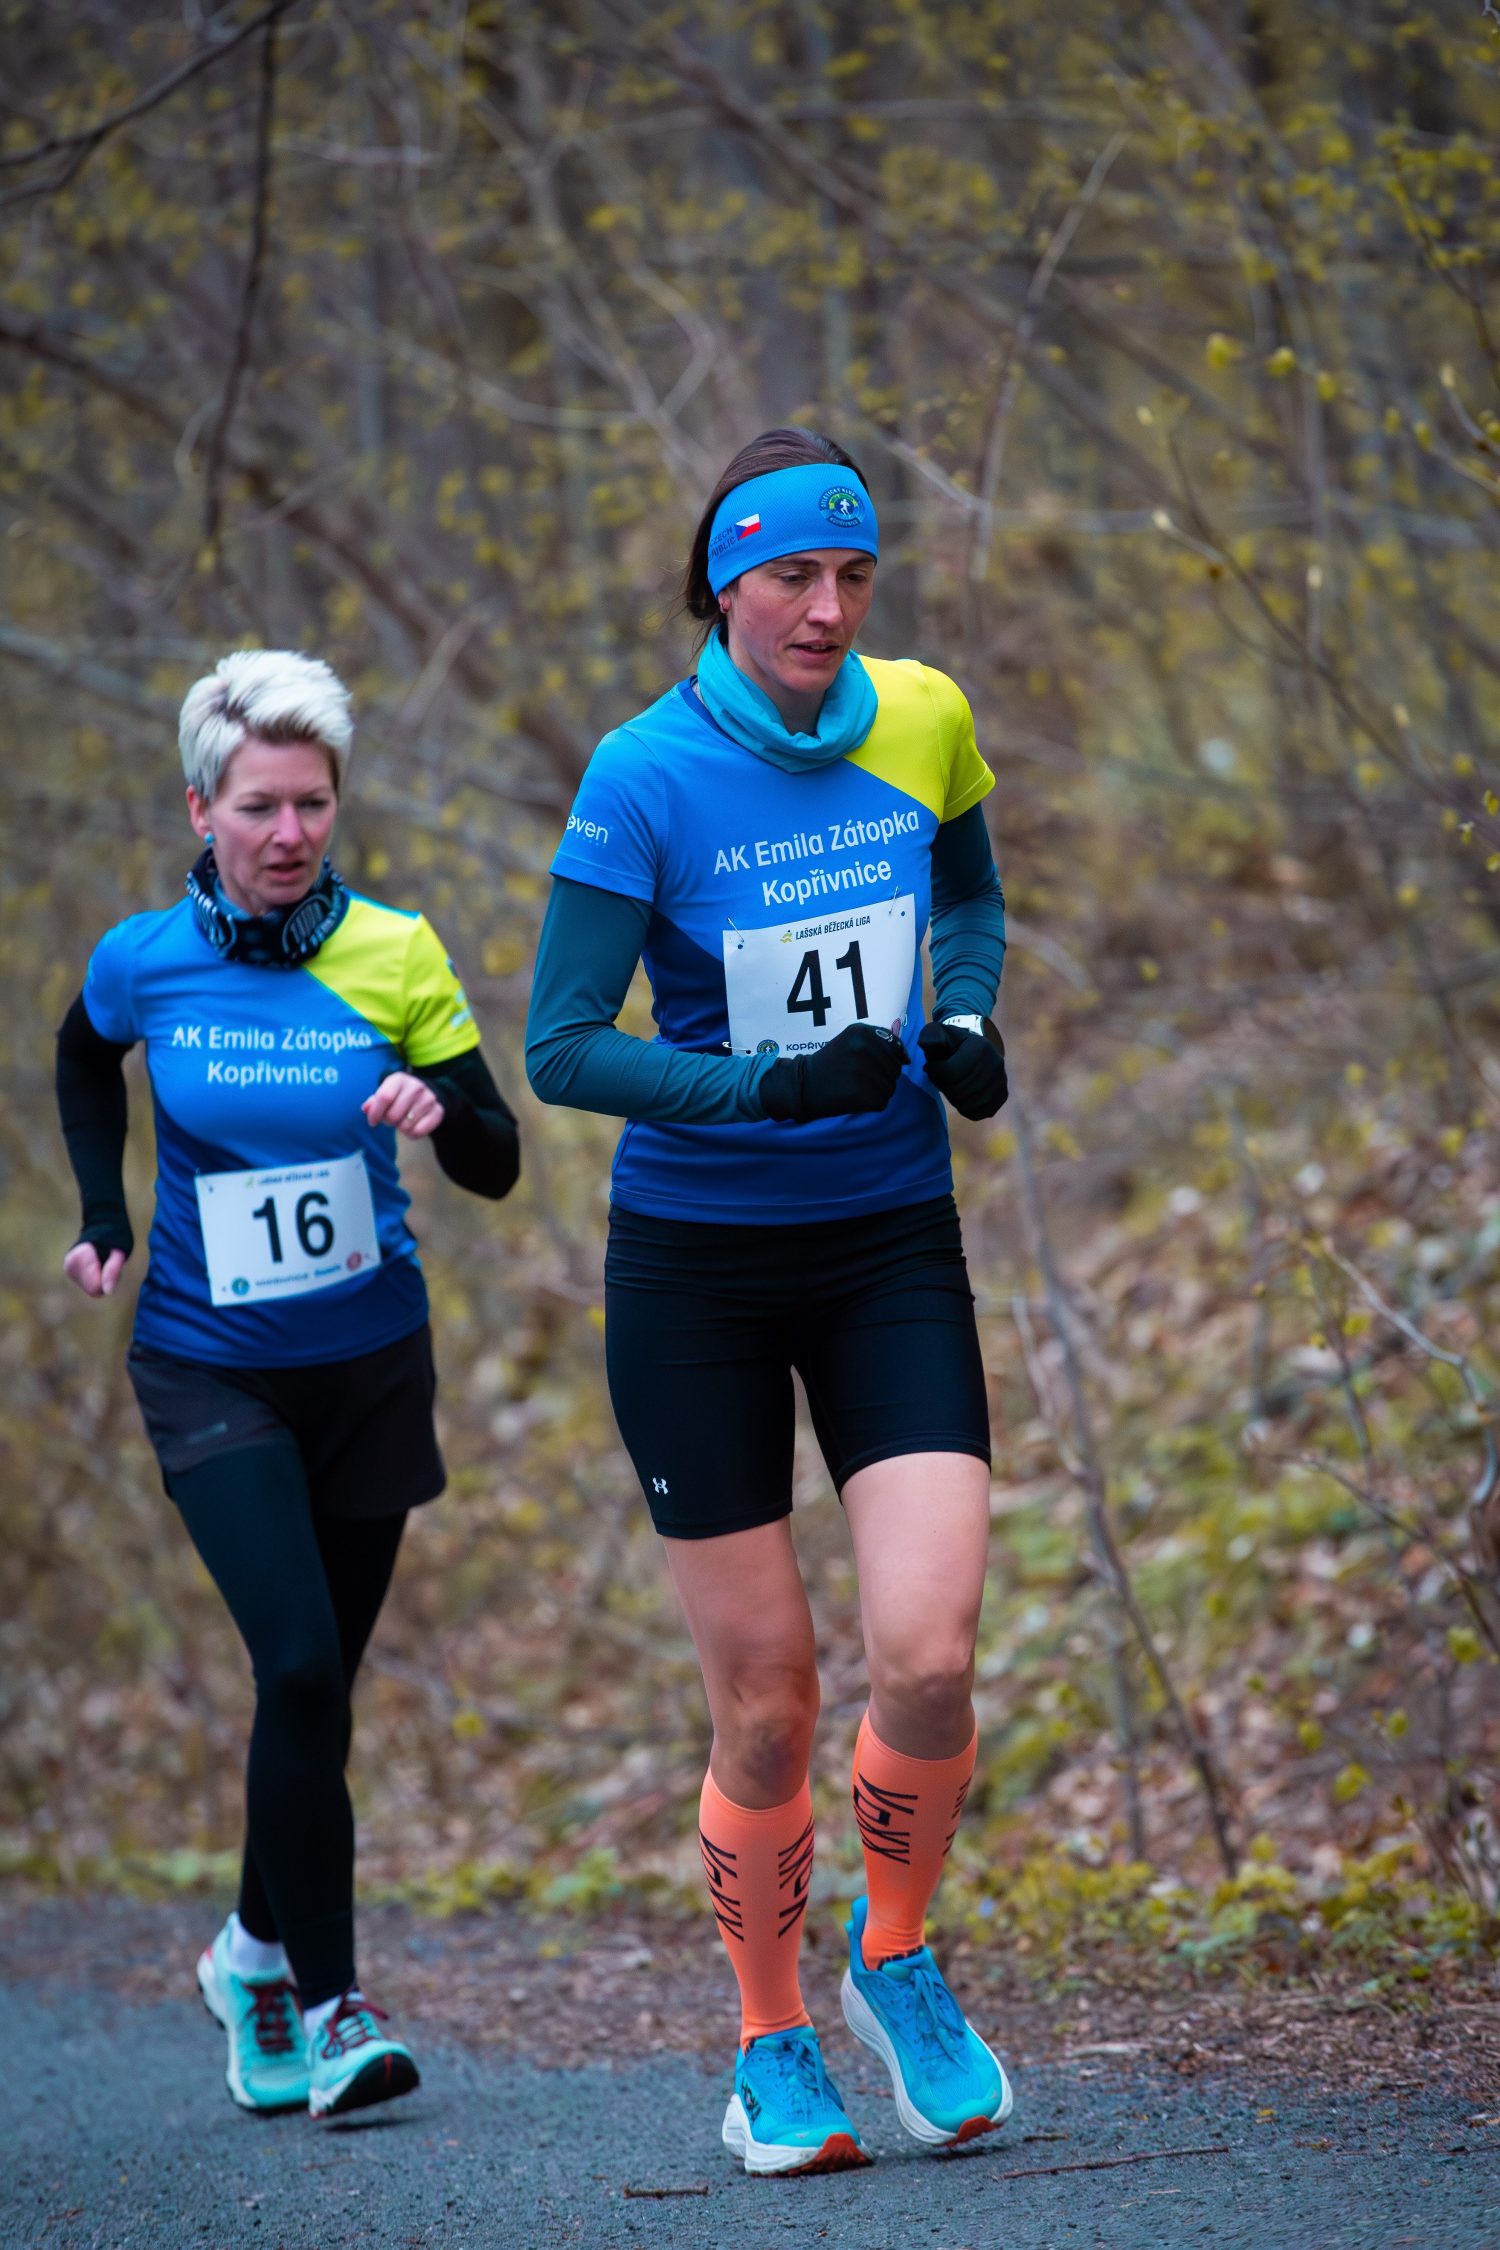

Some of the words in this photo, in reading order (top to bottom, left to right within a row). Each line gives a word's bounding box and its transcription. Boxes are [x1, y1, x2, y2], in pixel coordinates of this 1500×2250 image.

[714, 844, 750, 874] AK
[754, 833, 824, 867] Emila
[828, 810, 919, 851] Zátopka
[762, 859, 892, 906] Kopřivnice
[796, 924, 822, 940] LAŠSKÁ
[824, 917, 854, 934] BĚŽECKÁ
[855, 915, 871, 927] LIGA
[787, 940, 869, 1027] 41
[172, 1025, 202, 1048] AK
[208, 1025, 275, 1049] Emila
[281, 1024, 372, 1054] Zátopka
[786, 1041, 829, 1052] KOPŘIV
[207, 1060, 339, 1089] Kopřivnice
[252, 1191, 335, 1264] 16
